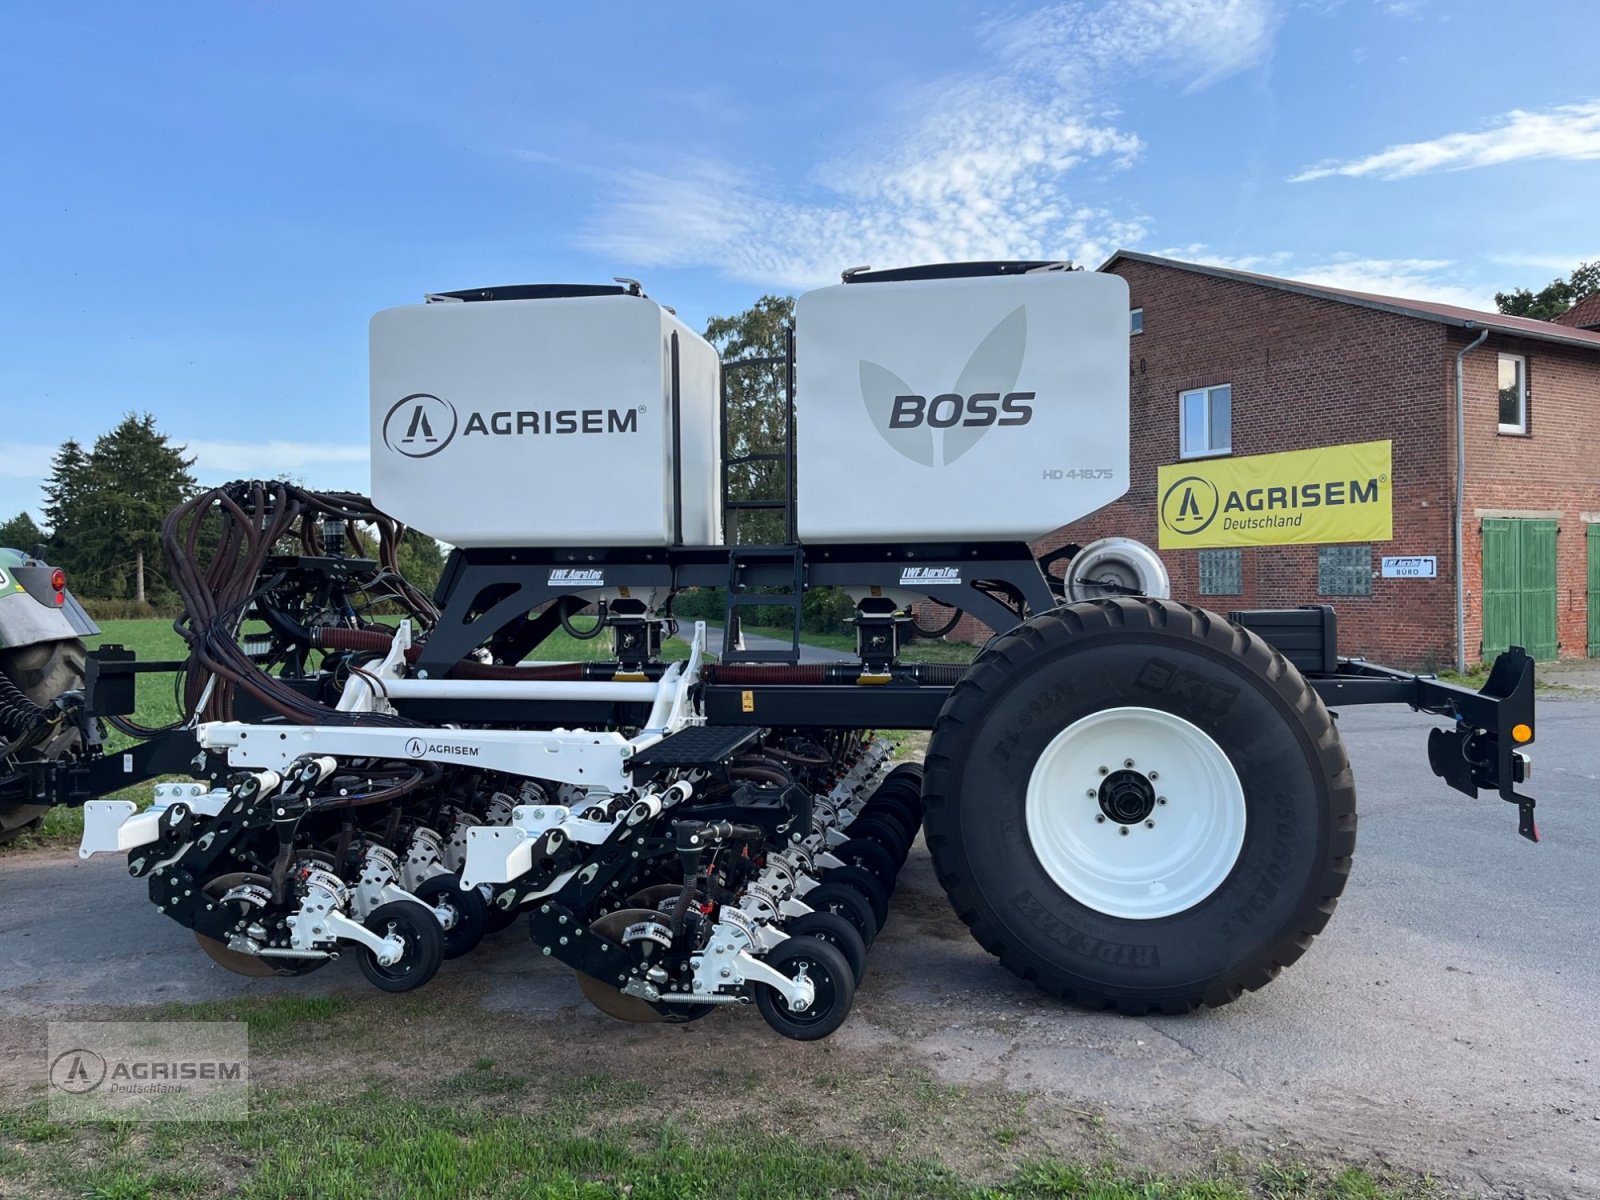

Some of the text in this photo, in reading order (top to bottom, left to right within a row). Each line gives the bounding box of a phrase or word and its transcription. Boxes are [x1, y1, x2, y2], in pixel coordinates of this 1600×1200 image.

[889, 391, 1036, 429] BOSS
[1042, 469, 1063, 480] HD
[1223, 513, 1303, 531] Deutschland
